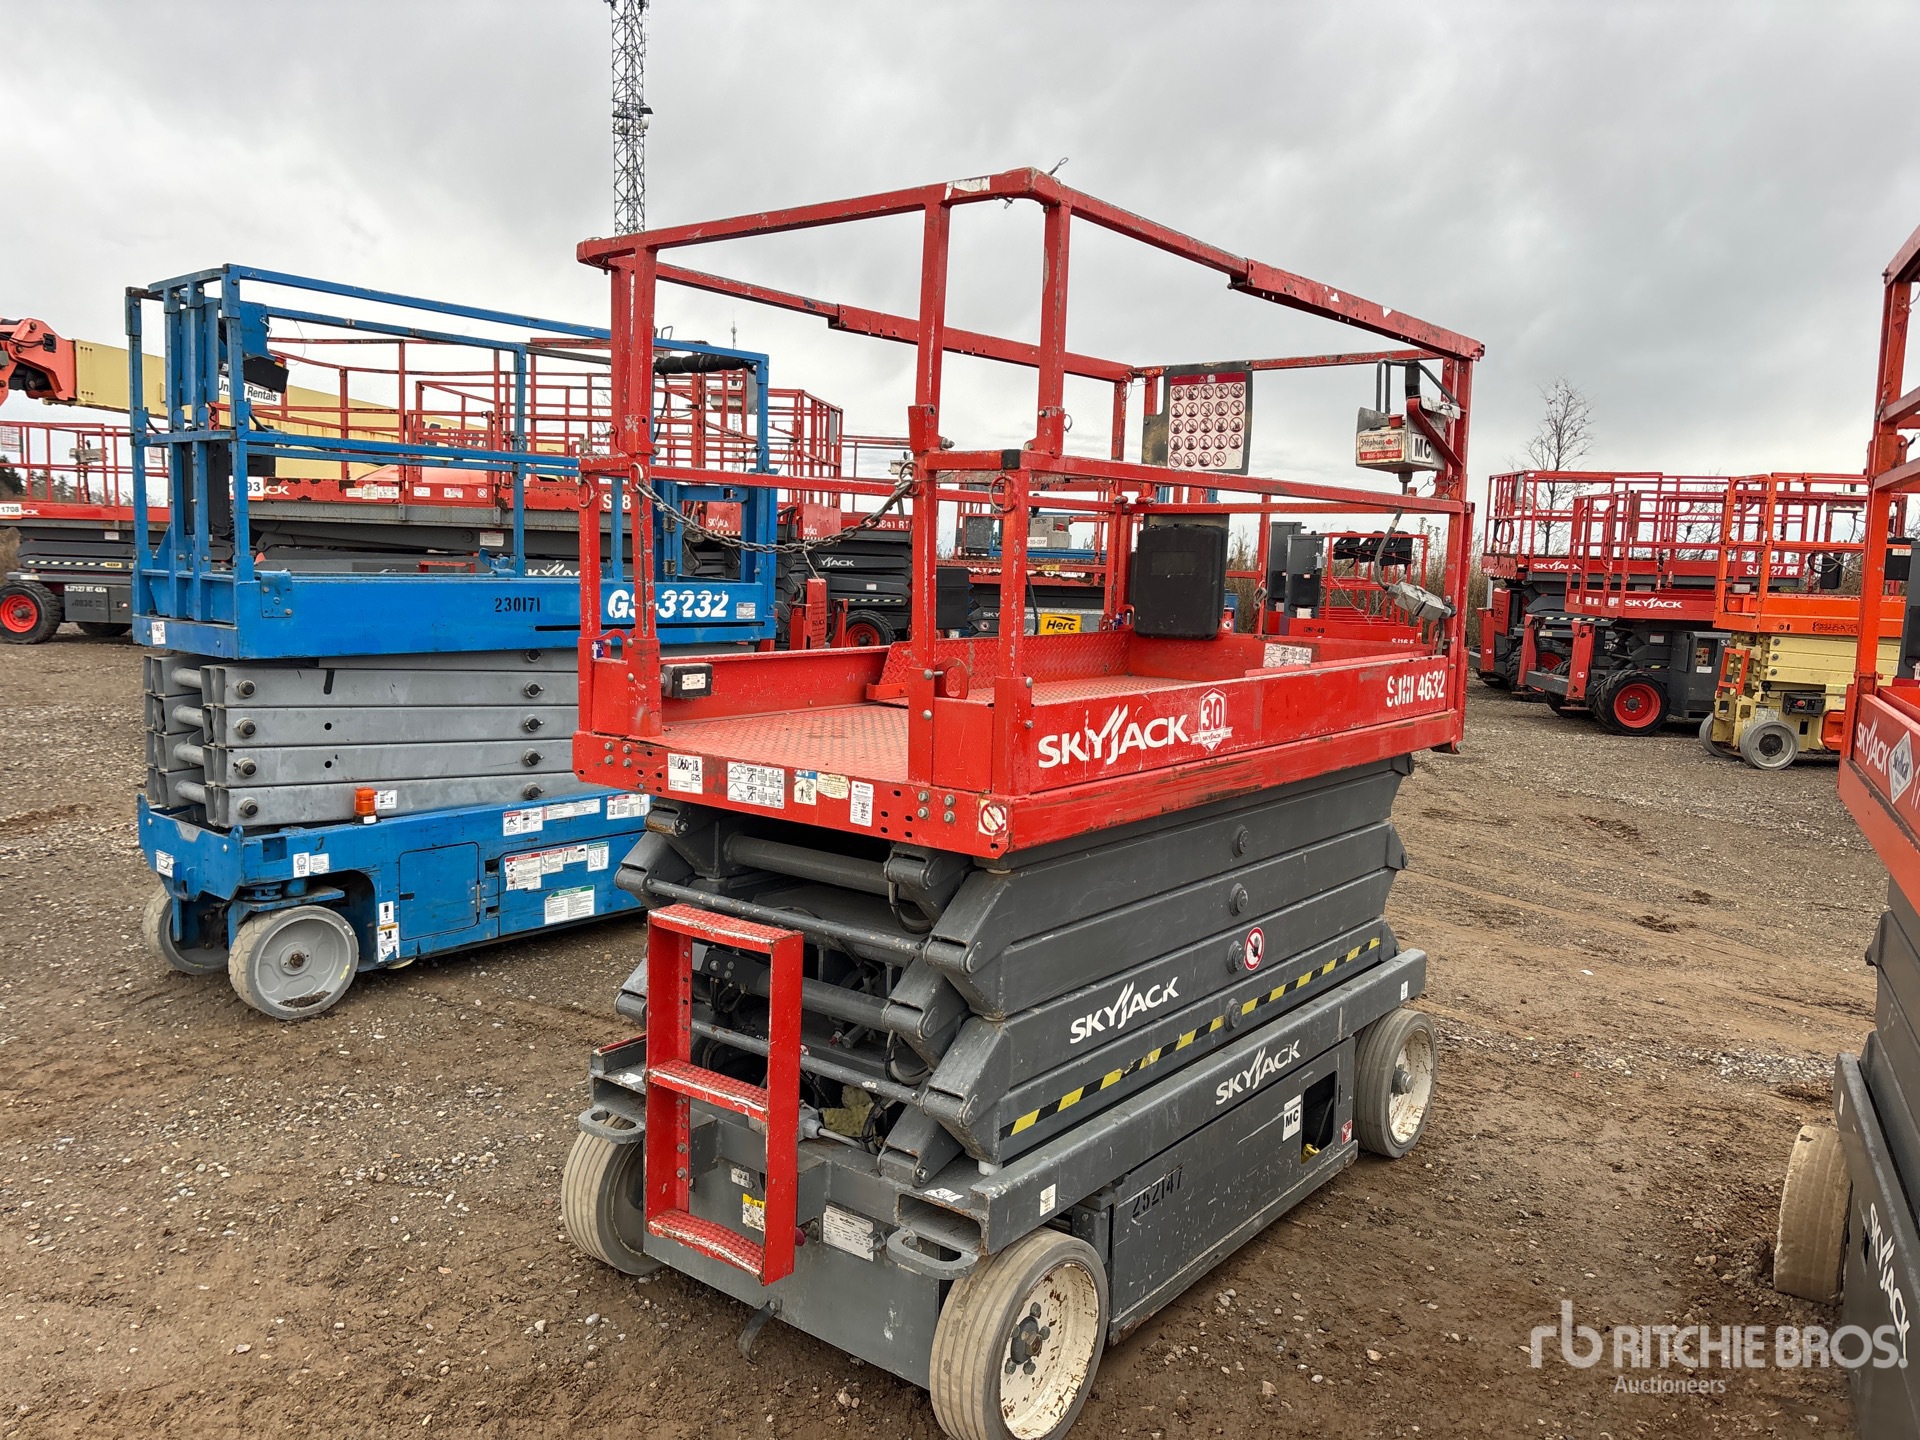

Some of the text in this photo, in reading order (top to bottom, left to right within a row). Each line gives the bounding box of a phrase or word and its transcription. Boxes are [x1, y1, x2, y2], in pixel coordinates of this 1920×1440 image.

[246, 386, 278, 402] Rentals
[1414, 437, 1432, 459] MC
[821, 556, 855, 568] YJACK
[494, 597, 541, 613] 230171
[607, 589, 729, 619] G-3232
[1624, 597, 1683, 609] SKYJACK
[1046, 619, 1076, 631] Herc
[1417, 669, 1446, 701] 4632
[1038, 697, 1223, 769] SKYJACK 30
[1856, 716, 1890, 776] SKYJACK
[1070, 975, 1179, 1044] SKYJACK
[1215, 1038, 1301, 1106] SKYJACK
[1285, 1108, 1299, 1128] MC
